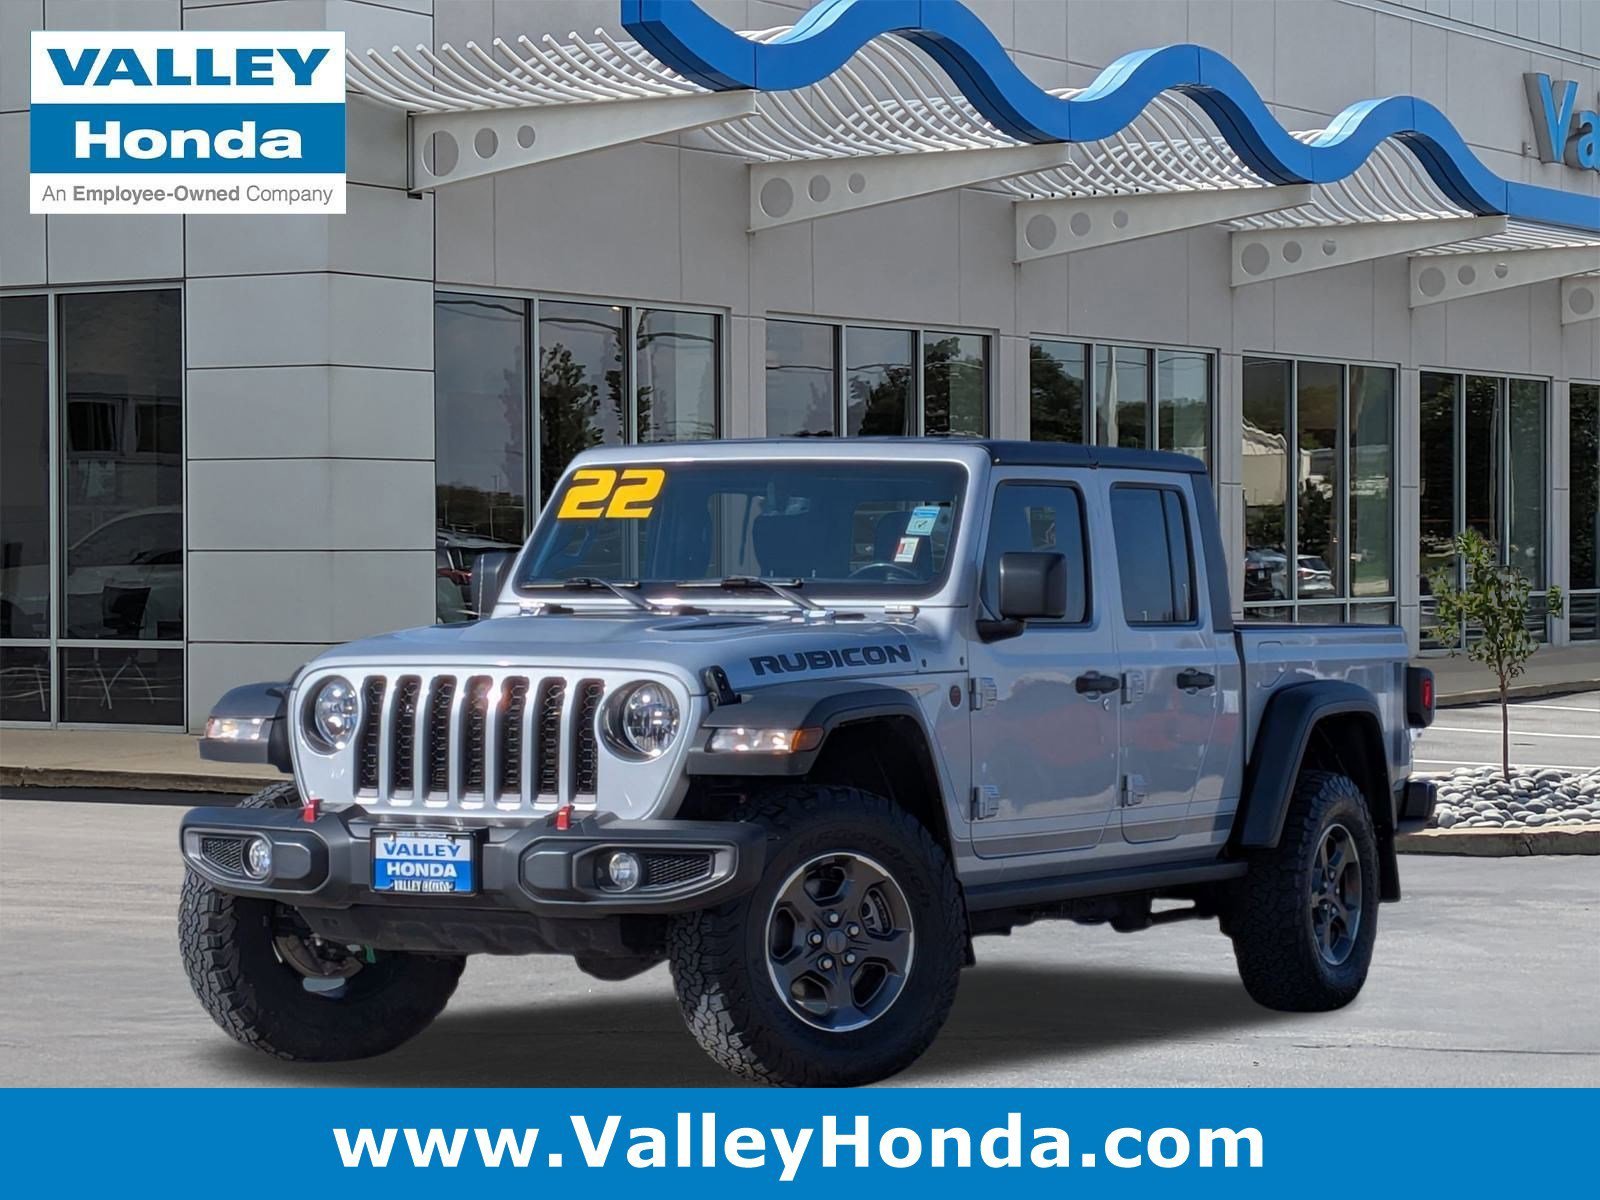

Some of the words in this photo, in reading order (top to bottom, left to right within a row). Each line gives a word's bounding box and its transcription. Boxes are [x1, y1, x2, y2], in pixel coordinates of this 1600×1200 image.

[557, 469, 666, 519] 22
[750, 644, 912, 676] RUBICON
[383, 842, 461, 857] VALLEY
[387, 862, 457, 877] HONDA
